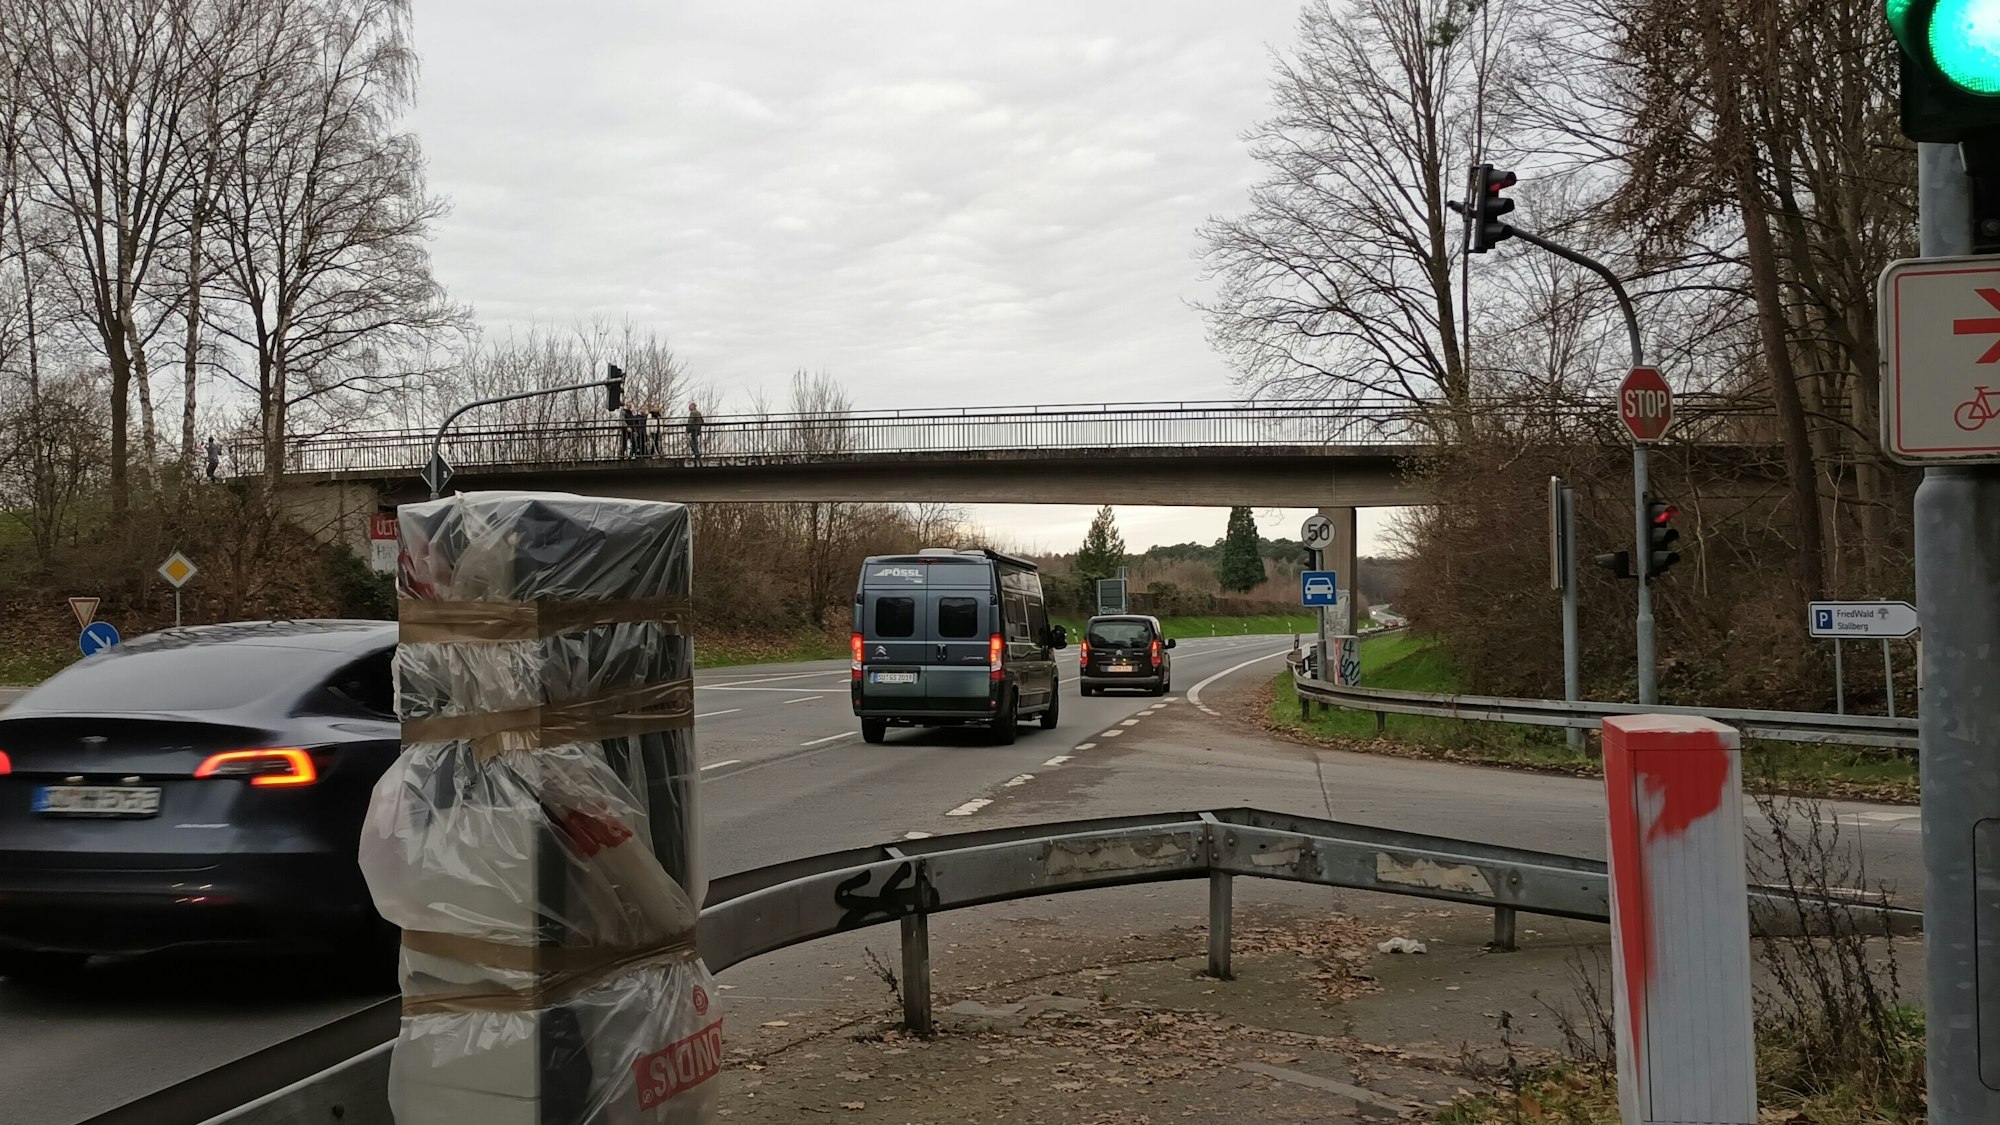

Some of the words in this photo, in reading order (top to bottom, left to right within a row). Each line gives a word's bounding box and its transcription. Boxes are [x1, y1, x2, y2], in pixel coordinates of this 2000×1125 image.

[1625, 389, 1667, 418] STOP
[1307, 523, 1330, 541] 50
[884, 567, 923, 577] PÖSSL
[1820, 611, 1829, 628] P
[1836, 609, 1874, 618] FriedWald
[1837, 622, 1869, 632] Stallberg
